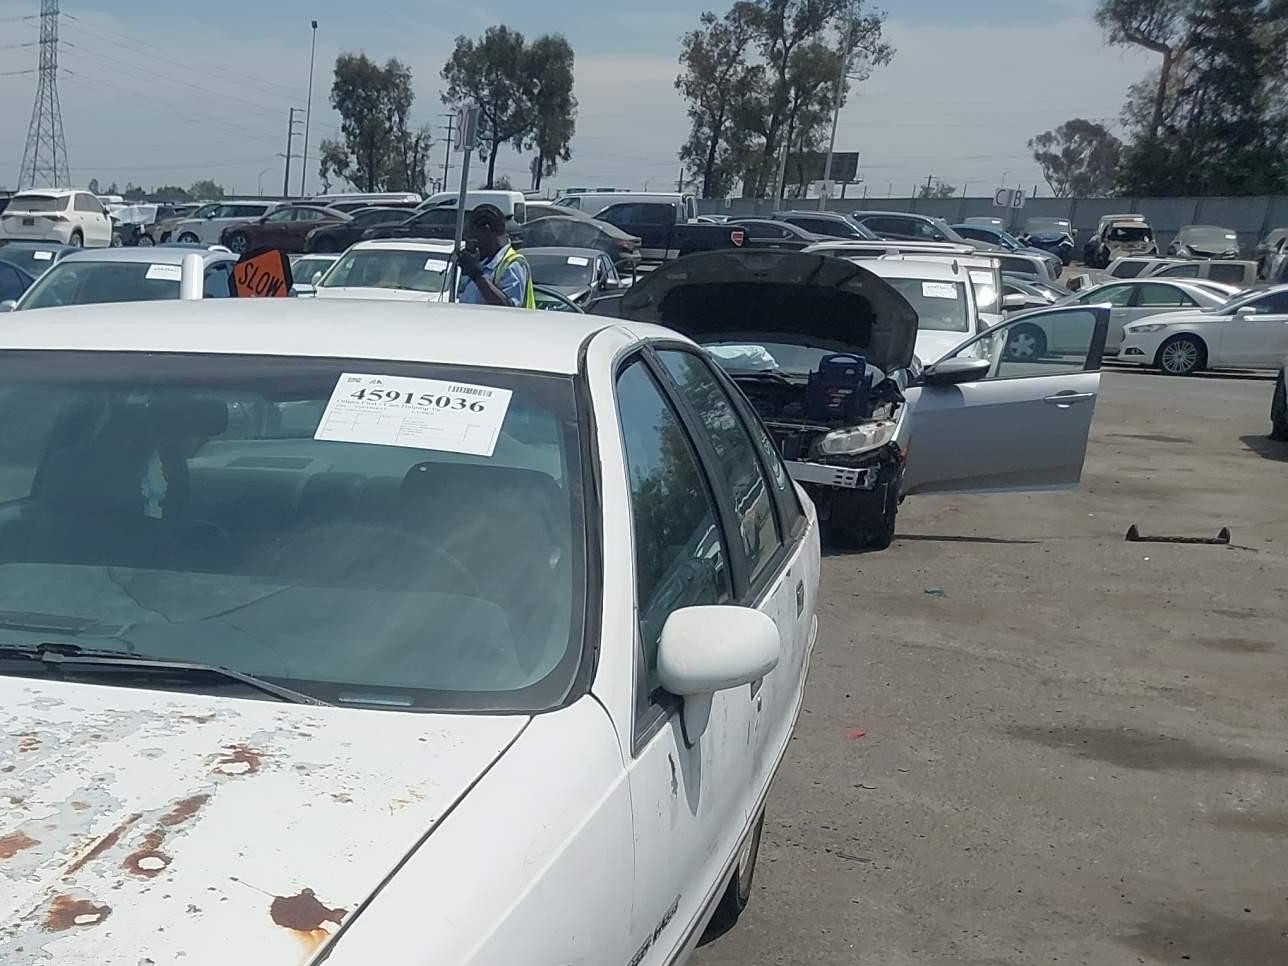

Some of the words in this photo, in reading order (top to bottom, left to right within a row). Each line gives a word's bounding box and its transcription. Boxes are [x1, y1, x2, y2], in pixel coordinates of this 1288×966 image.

[995, 189, 1006, 206] C
[1013, 190, 1023, 207] B
[238, 262, 284, 297] SLOW
[350, 388, 486, 413] 45915036
